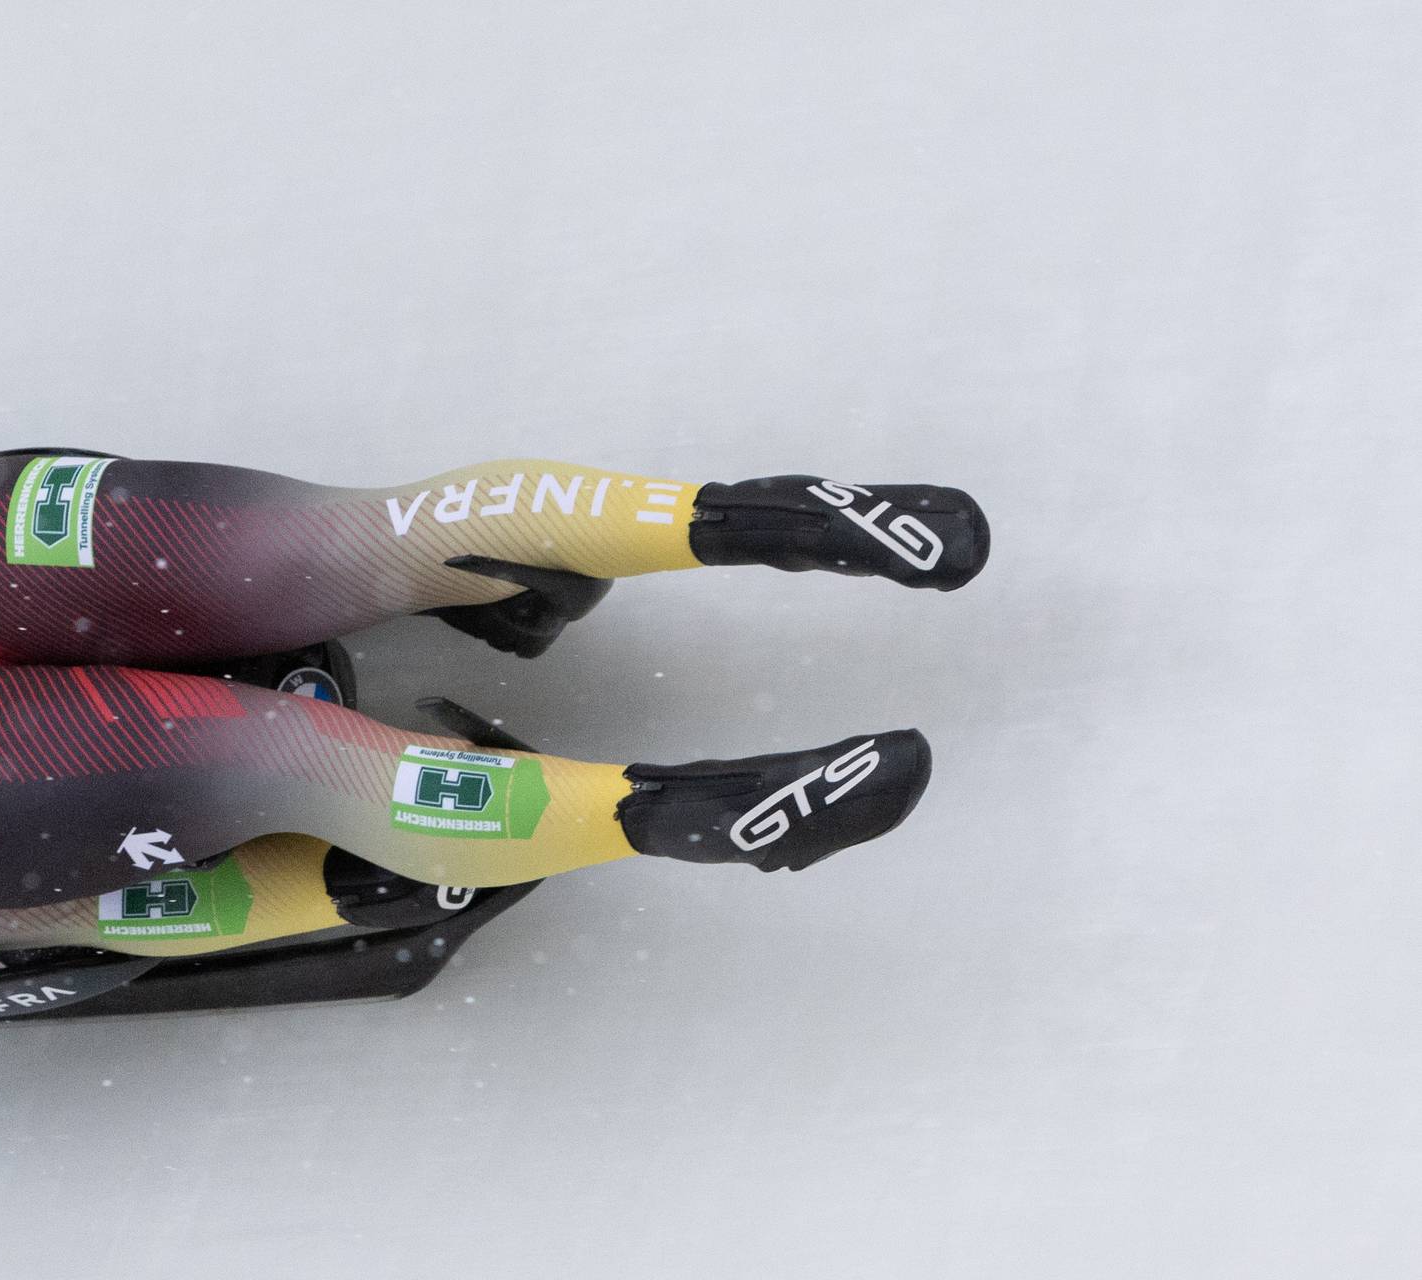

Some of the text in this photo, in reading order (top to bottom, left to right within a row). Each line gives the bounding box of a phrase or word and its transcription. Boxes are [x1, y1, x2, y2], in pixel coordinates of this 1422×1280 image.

[80, 491, 93, 550] Tunnelling
[806, 480, 944, 571] GTS
[419, 749, 503, 765] Tunnelling Systems
[730, 739, 880, 851] GTS
[395, 811, 502, 832] HERRENKNECHT
[104, 923, 212, 936] HERRENKNECHT
